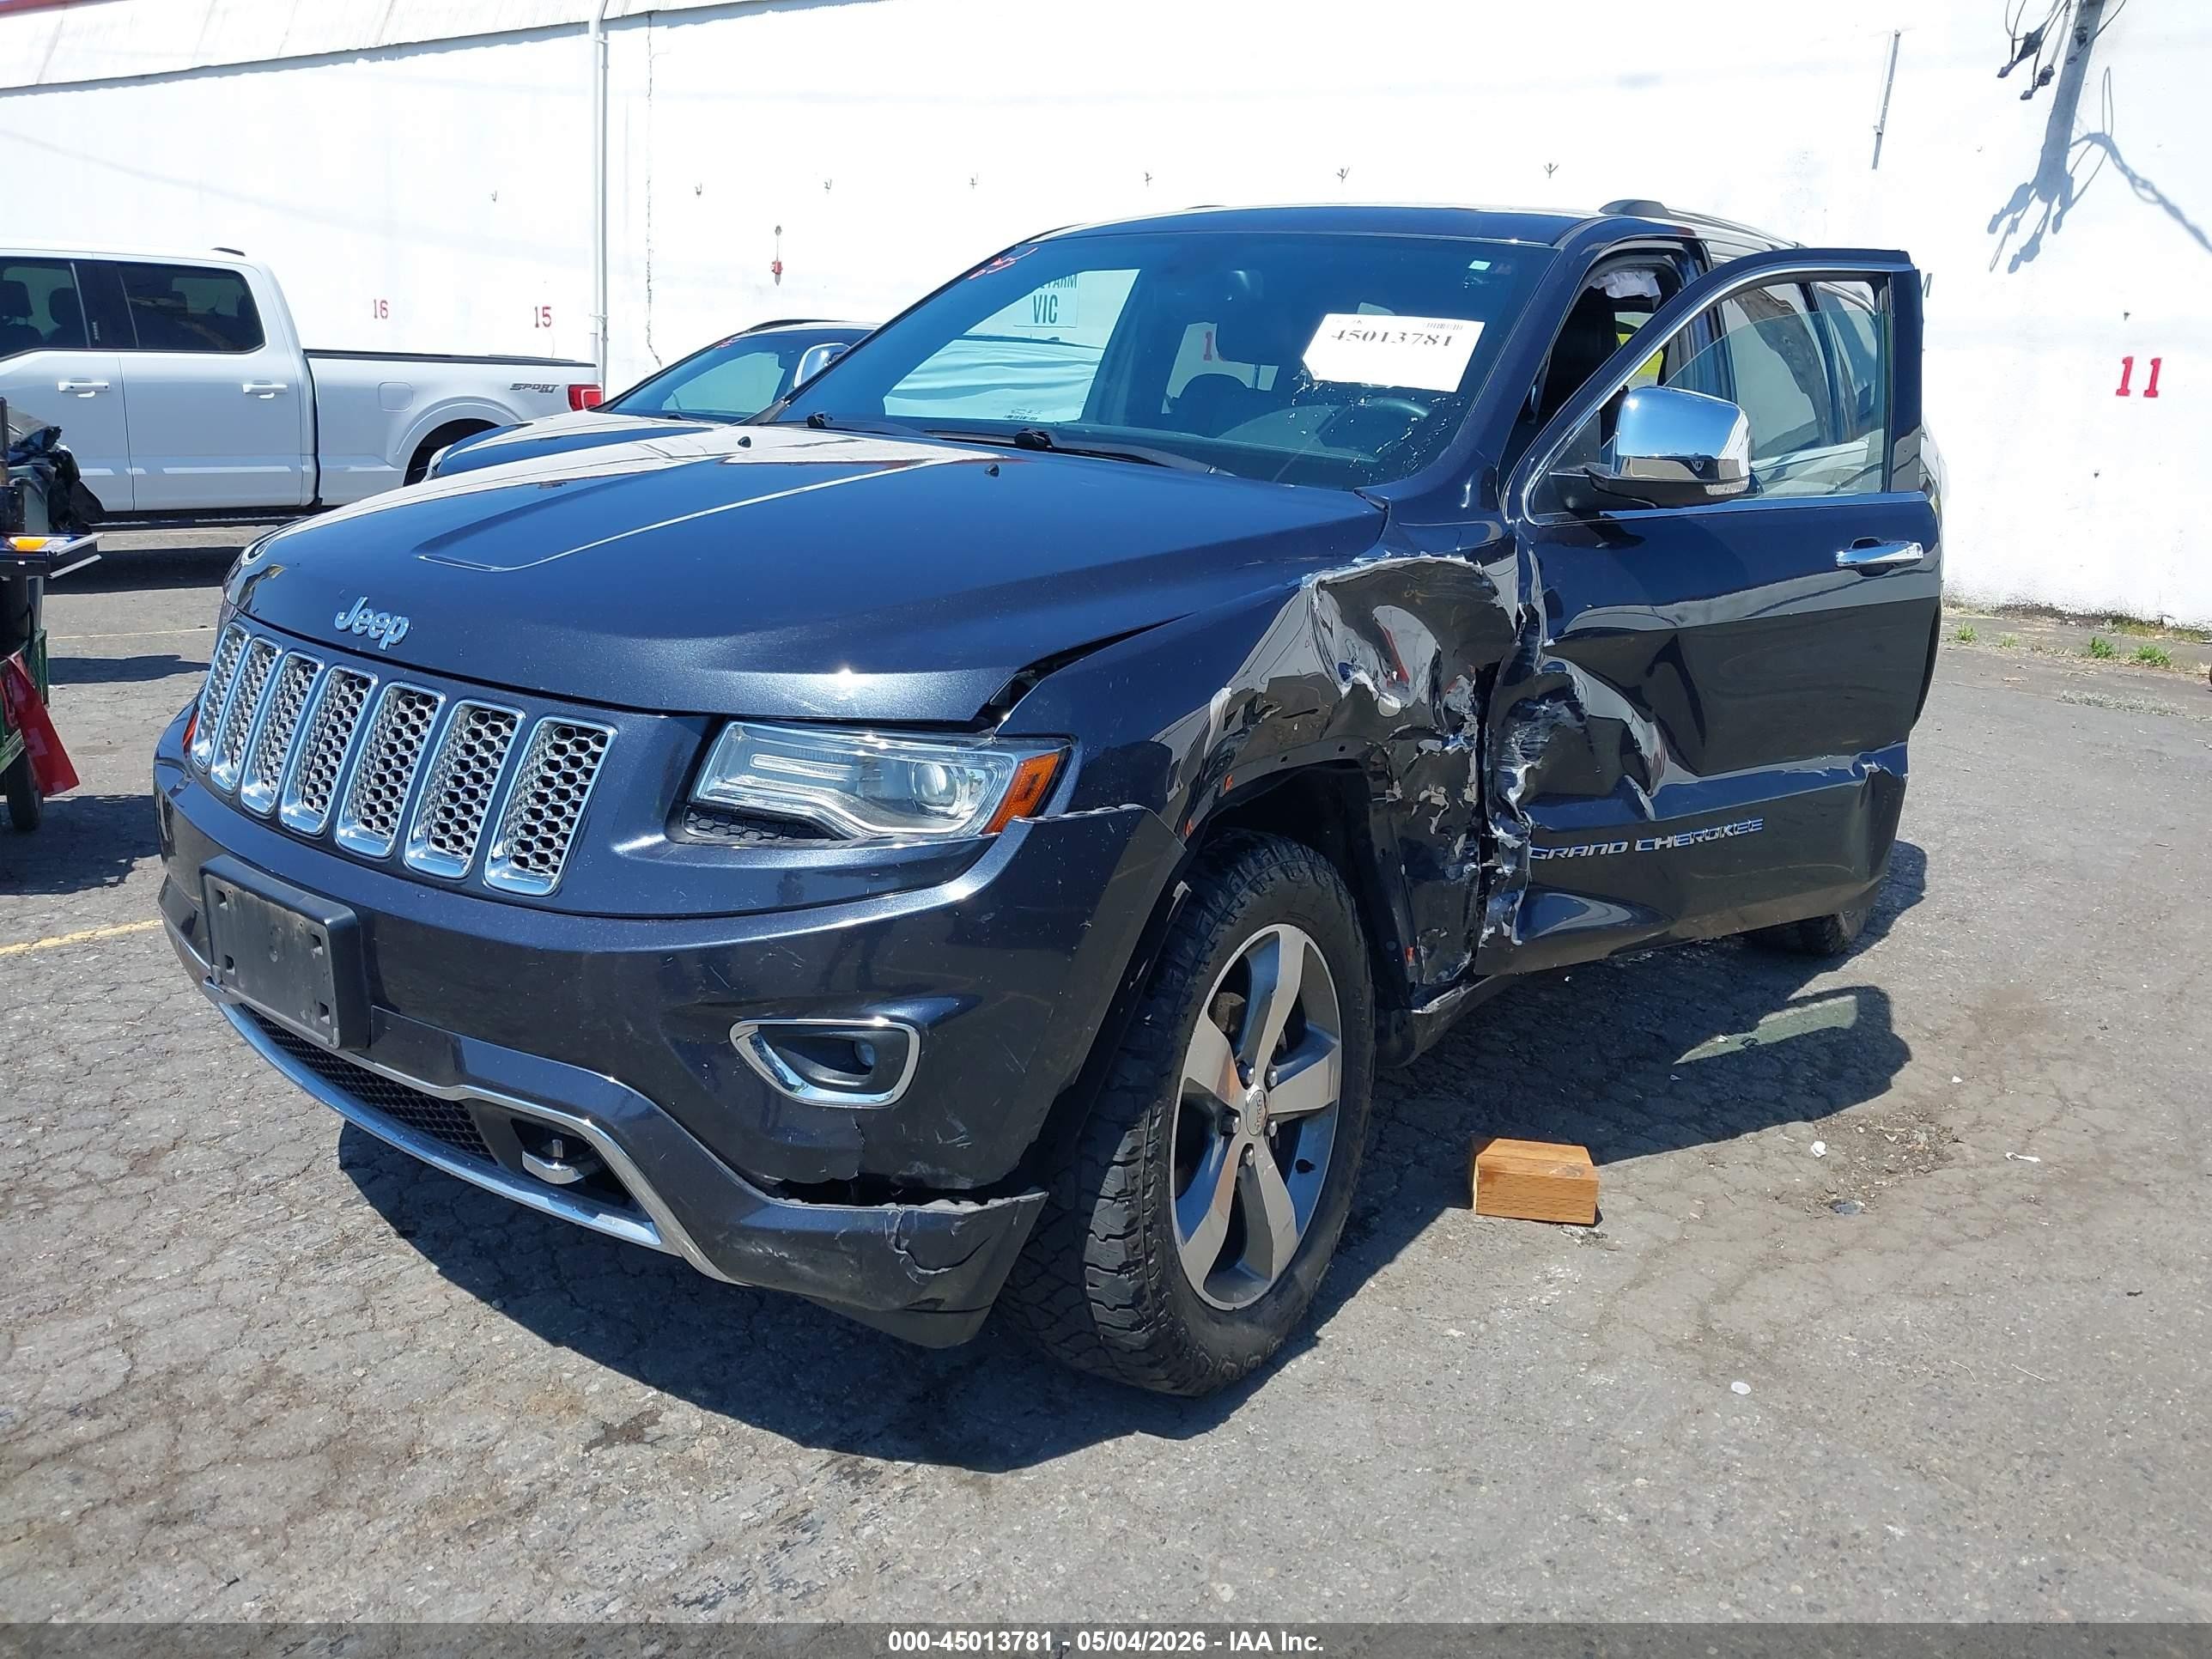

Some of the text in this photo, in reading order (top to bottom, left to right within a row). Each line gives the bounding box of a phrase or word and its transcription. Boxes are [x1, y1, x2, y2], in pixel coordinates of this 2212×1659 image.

[374, 299, 388, 319] 16
[535, 306, 552, 328] 15
[1033, 295, 1059, 324] VIC
[1331, 329, 1453, 347] 45013781
[509, 383, 560, 393] SPORT
[2115, 356, 2162, 398] 11
[334, 596, 410, 651] Jeep
[1528, 818, 1764, 860] GRAND CHEROKEE
